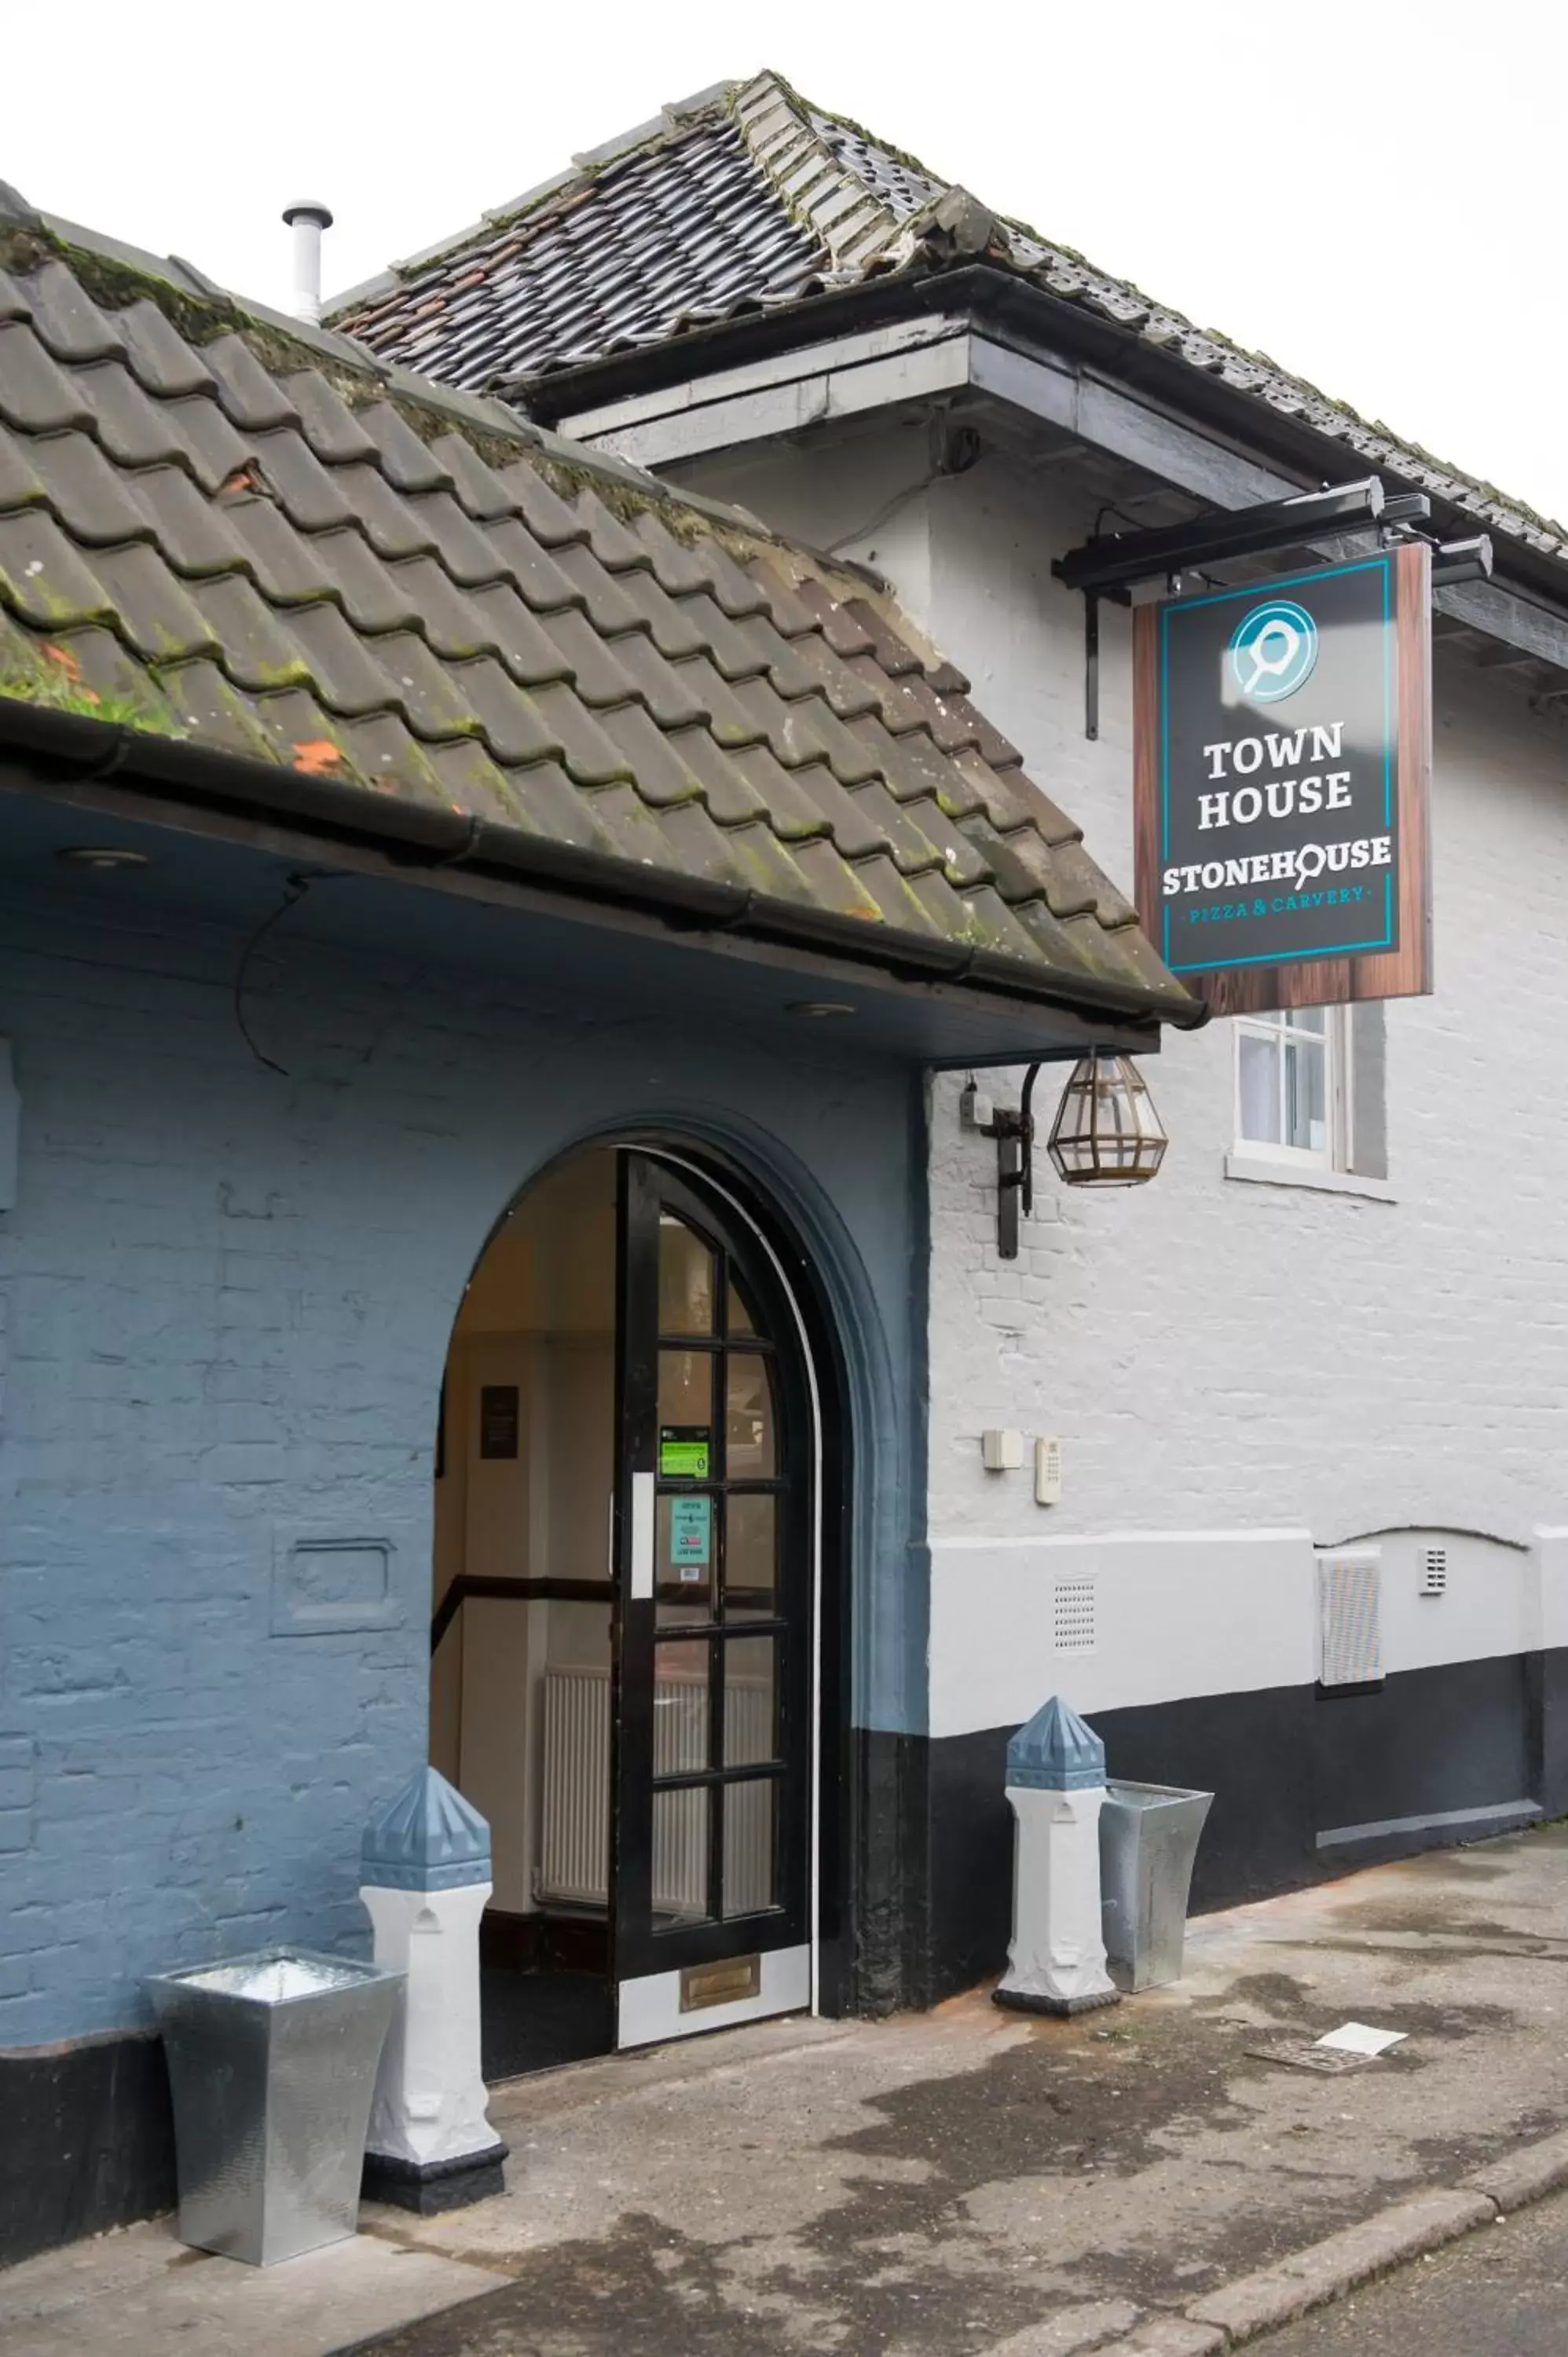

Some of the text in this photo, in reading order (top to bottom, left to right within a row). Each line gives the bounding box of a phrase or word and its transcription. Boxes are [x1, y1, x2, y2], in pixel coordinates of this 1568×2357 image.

[1203, 722, 1344, 779] TOWN
[1197, 771, 1352, 830] HOUSE
[1163, 836, 1391, 895] STONEHOUSE
[1190, 885, 1363, 924] PIZZA & CARVERY
